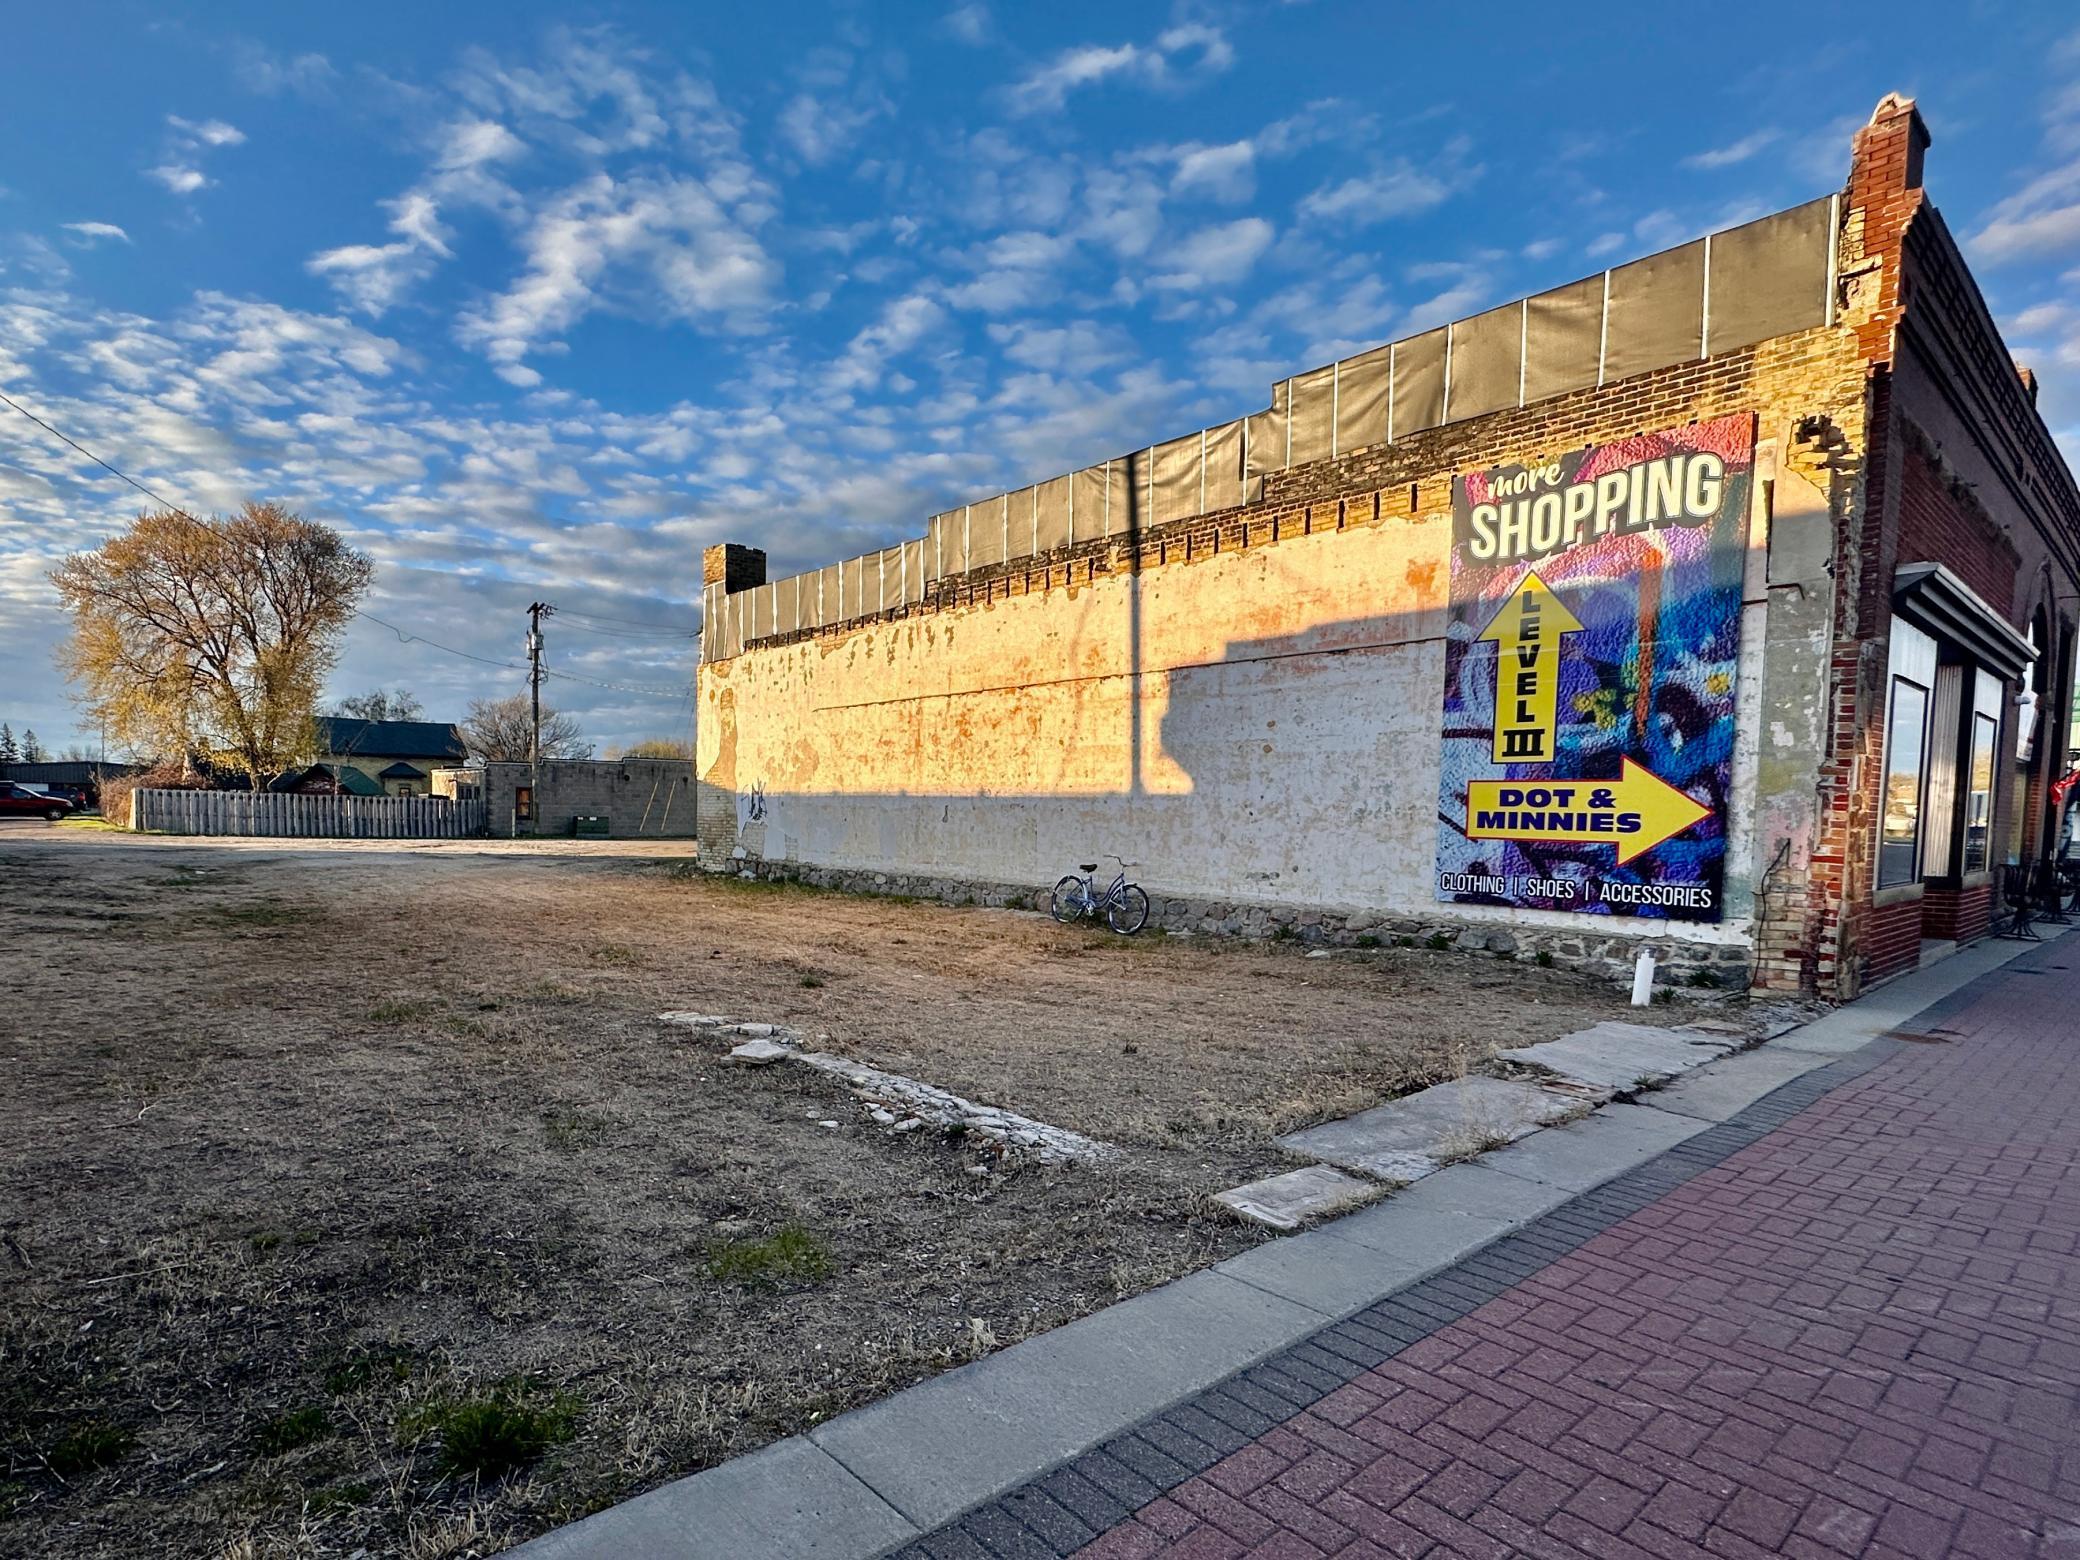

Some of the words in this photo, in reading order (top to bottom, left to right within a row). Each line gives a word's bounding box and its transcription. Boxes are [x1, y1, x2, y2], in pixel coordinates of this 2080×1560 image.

[1487, 462, 1565, 500] more
[1470, 453, 1724, 560] SHOPPING
[1515, 590, 1541, 723] LEVEL
[1501, 728, 1546, 757] III
[1499, 788, 1575, 808] DOT
[1587, 788, 1616, 809] &
[1476, 811, 1642, 834] MINNIES
[1440, 872, 1505, 895] CLOTHING
[1527, 878, 1575, 899] SHOES
[1599, 884, 1712, 908] ACCESSORIES
